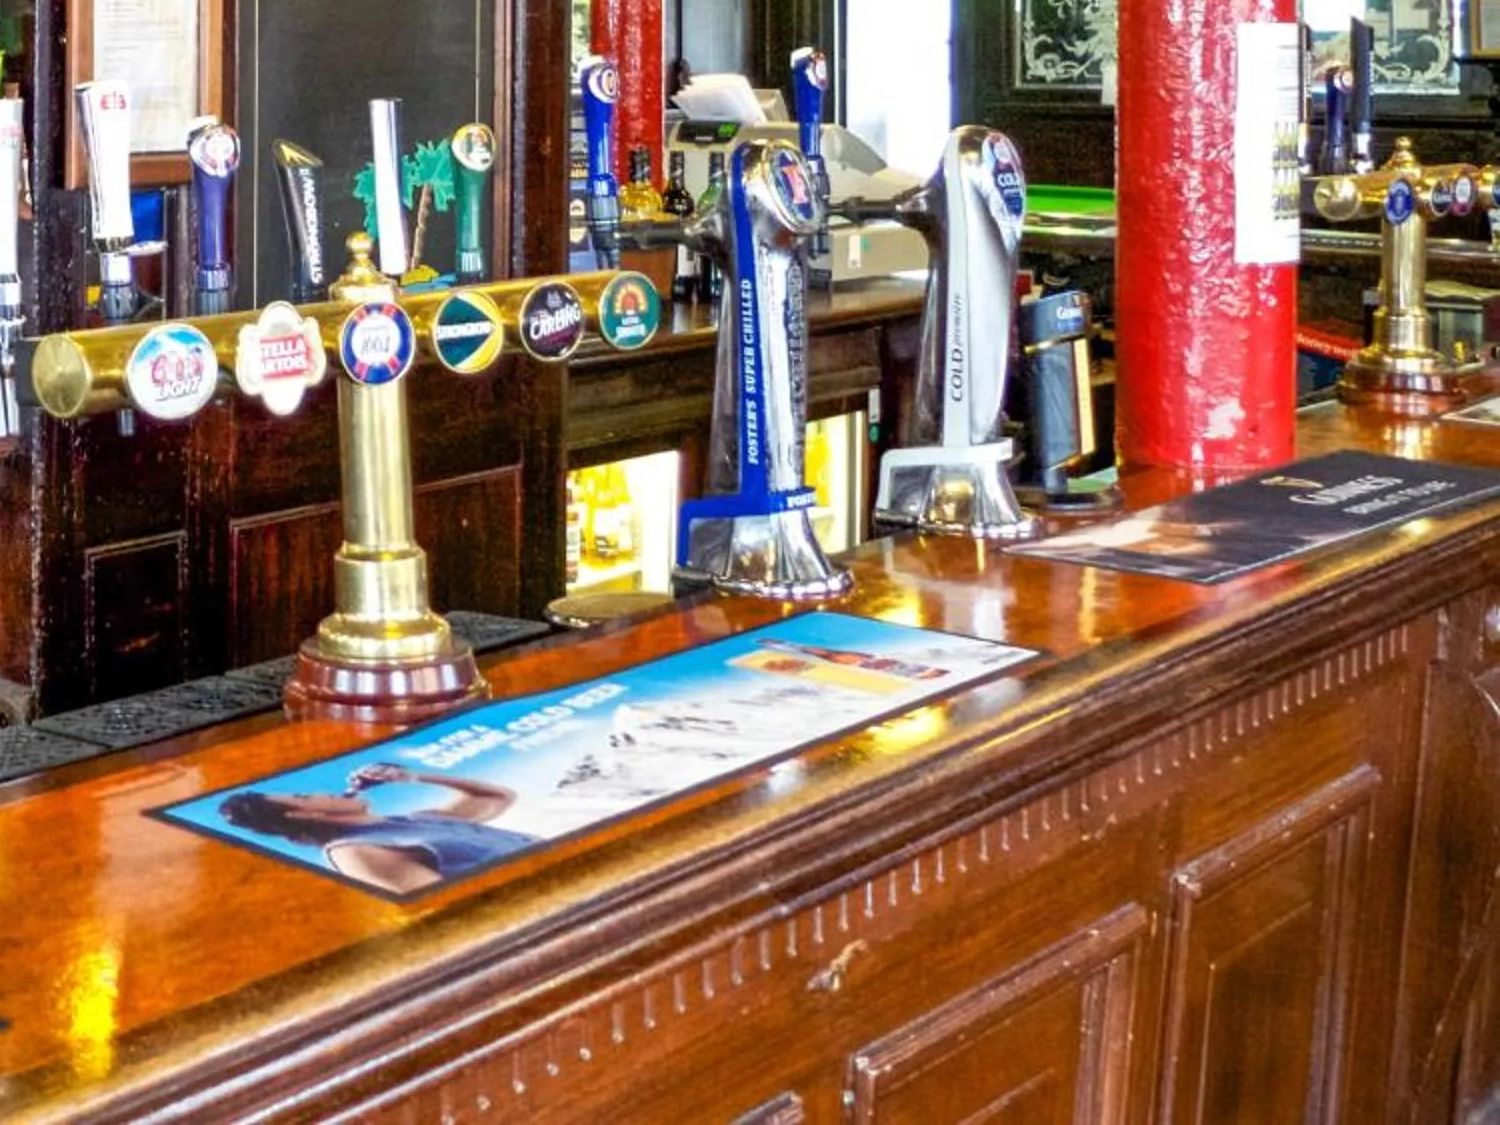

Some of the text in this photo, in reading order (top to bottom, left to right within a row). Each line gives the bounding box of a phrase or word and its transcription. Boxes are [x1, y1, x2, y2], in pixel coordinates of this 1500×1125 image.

[254, 341, 306, 358] TELLA
[256, 357, 307, 374] RTOIS
[950, 348, 966, 404] COLD
